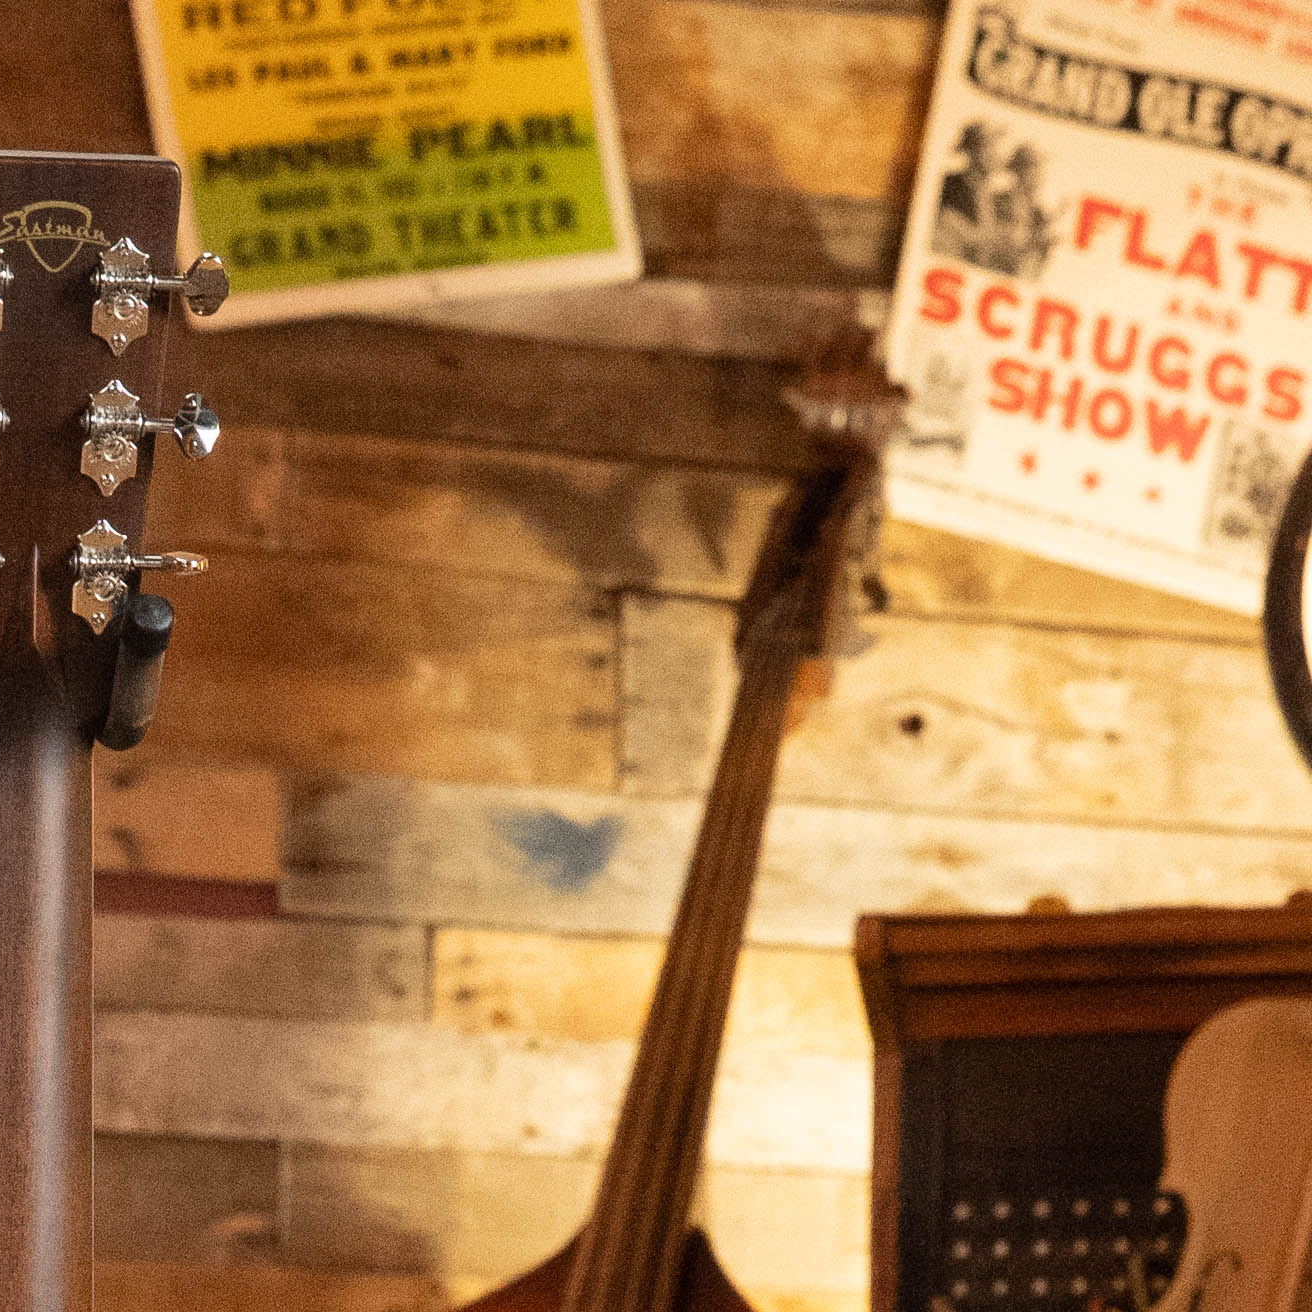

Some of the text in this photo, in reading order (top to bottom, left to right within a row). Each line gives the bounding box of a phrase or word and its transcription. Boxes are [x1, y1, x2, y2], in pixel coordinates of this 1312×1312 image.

[408, 113, 599, 163] PEARL
[1229, 92, 1312, 178] OP
[389, 199, 580, 249] THEATER
[1073, 196, 1312, 316] FLATT
[919, 267, 1304, 423] SCRUGGS
[987, 357, 1211, 463] SHOW
